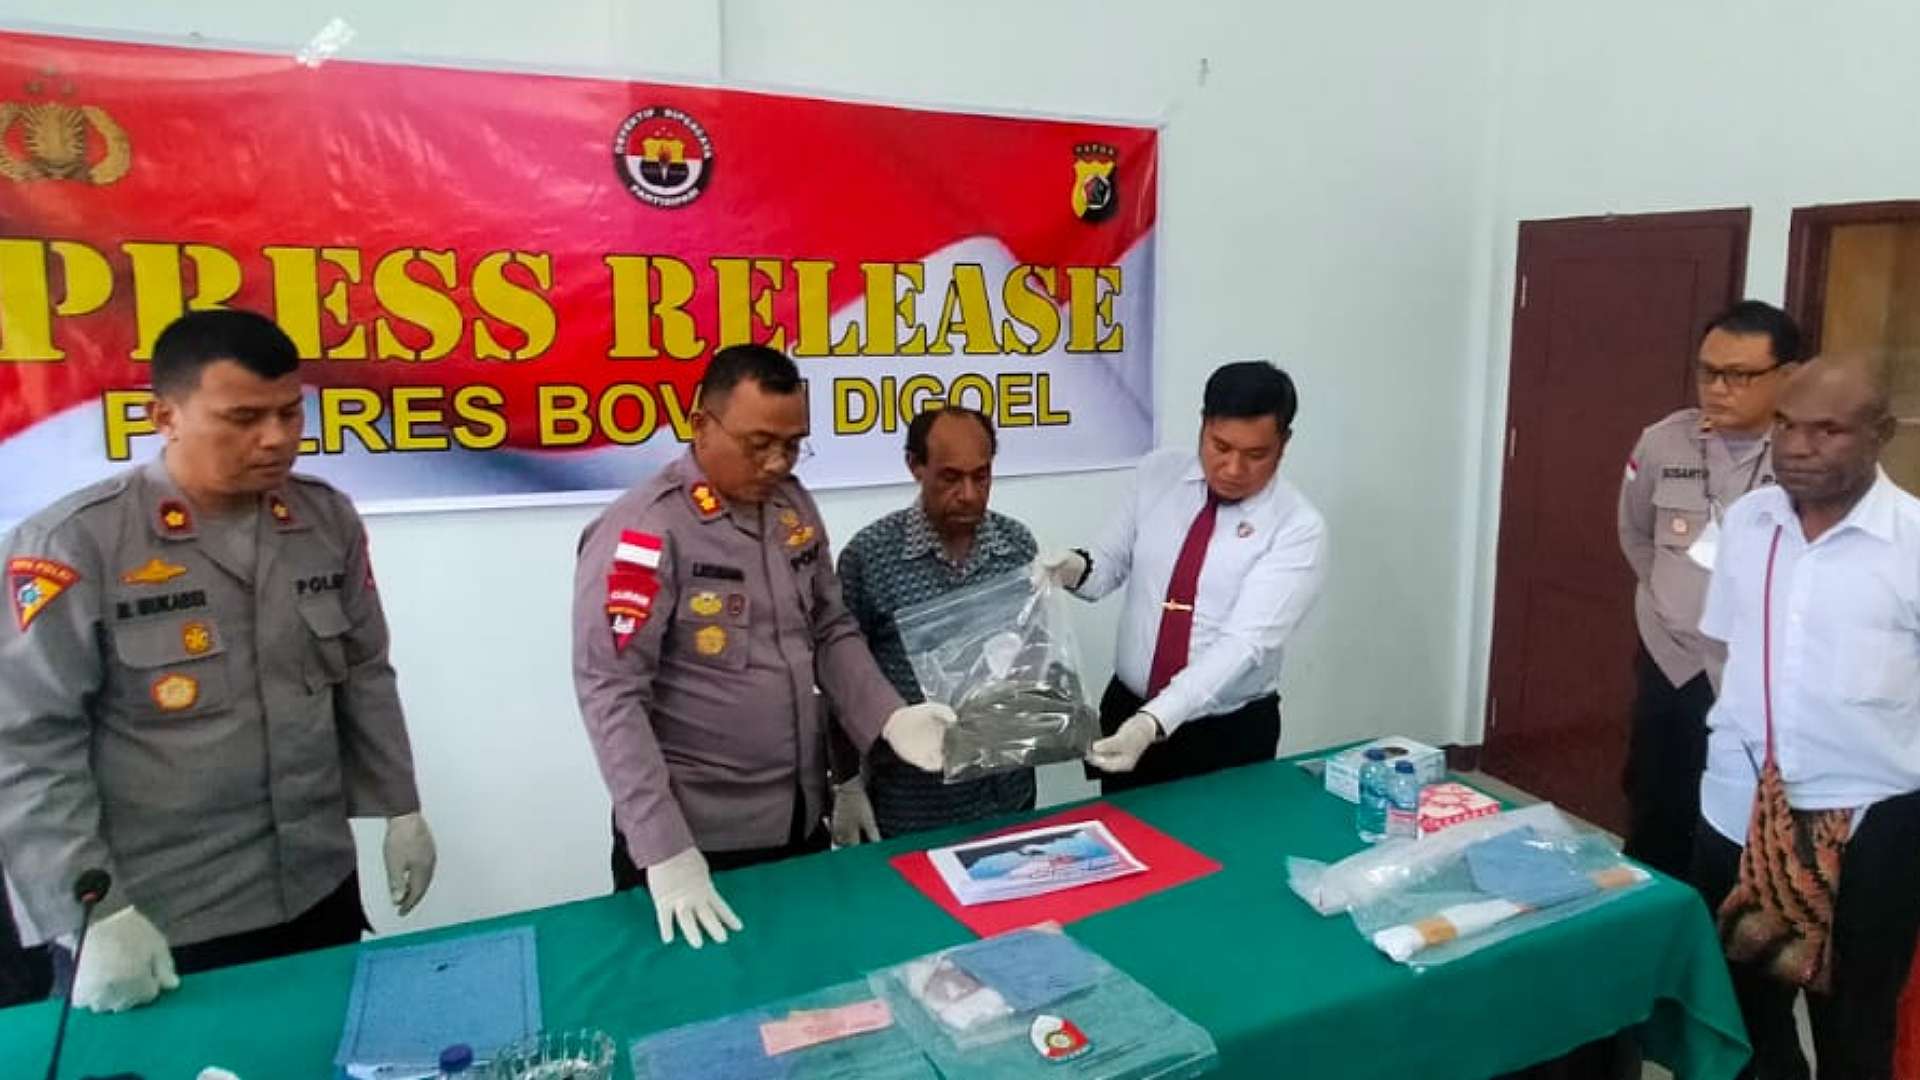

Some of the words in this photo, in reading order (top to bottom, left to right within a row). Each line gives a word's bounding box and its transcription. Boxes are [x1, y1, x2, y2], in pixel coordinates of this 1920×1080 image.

[0, 238, 557, 362] PRESS
[604, 255, 1124, 360] RELEASE
[103, 386, 508, 461] PRES
